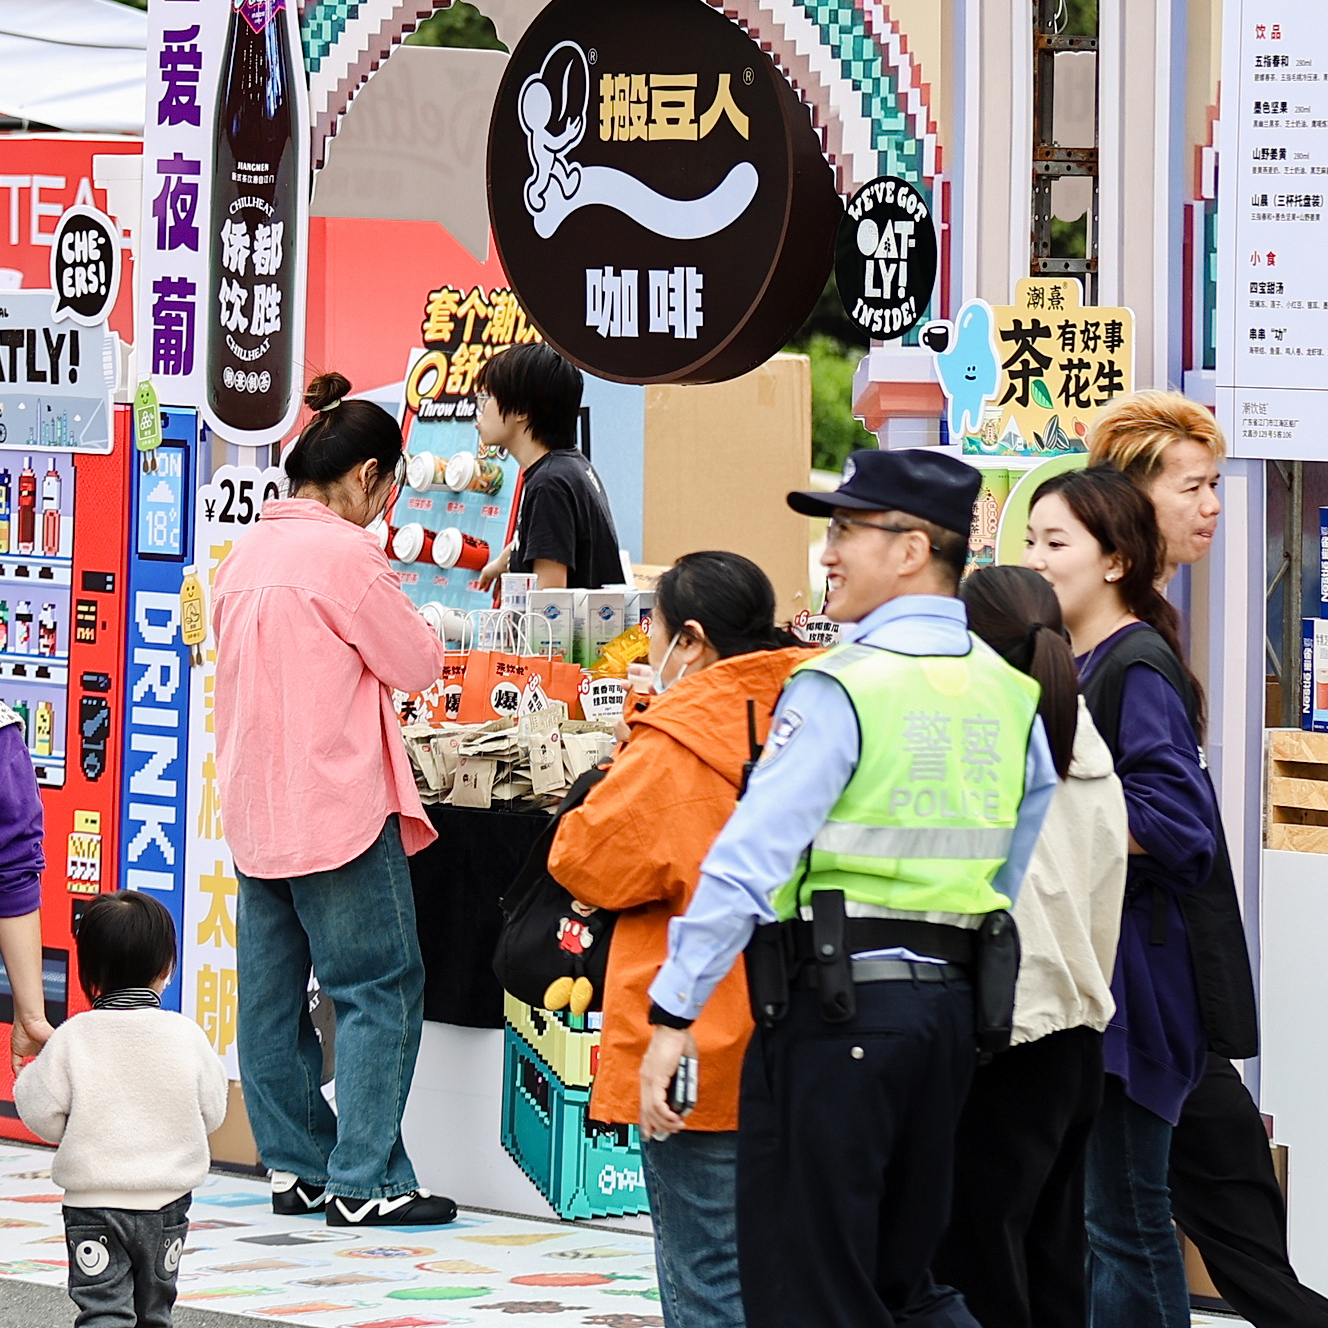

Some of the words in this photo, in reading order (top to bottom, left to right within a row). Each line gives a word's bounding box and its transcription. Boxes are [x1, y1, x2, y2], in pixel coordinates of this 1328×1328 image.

[1255, 24, 1282, 40] 饮品
[598, 72, 750, 142] 搬豆人
[237, 161, 270, 172] JIANGMEN
[1252, 147, 1287, 161] 山野姜黄
[229, 196, 275, 218] CHILLHEAT
[897, 186, 928, 222] GOT
[220, 218, 285, 276] 侨都
[1250, 250, 1277, 267] 小食
[585, 265, 704, 339] 咖啡
[1249, 282, 1284, 295] 四宝甜汤
[852, 295, 917, 334] INSIDE!
[225, 334, 272, 362] CHILLHEAT
[1056, 319, 1125, 354] 有好事
[998, 318, 1054, 409] 茶
[1056, 357, 1124, 409] 花生
[419, 398, 455, 417] Throw
[455, 399, 475, 417] the
[902, 711, 1002, 783] 警察
[888, 788, 1000, 820] POLICE
